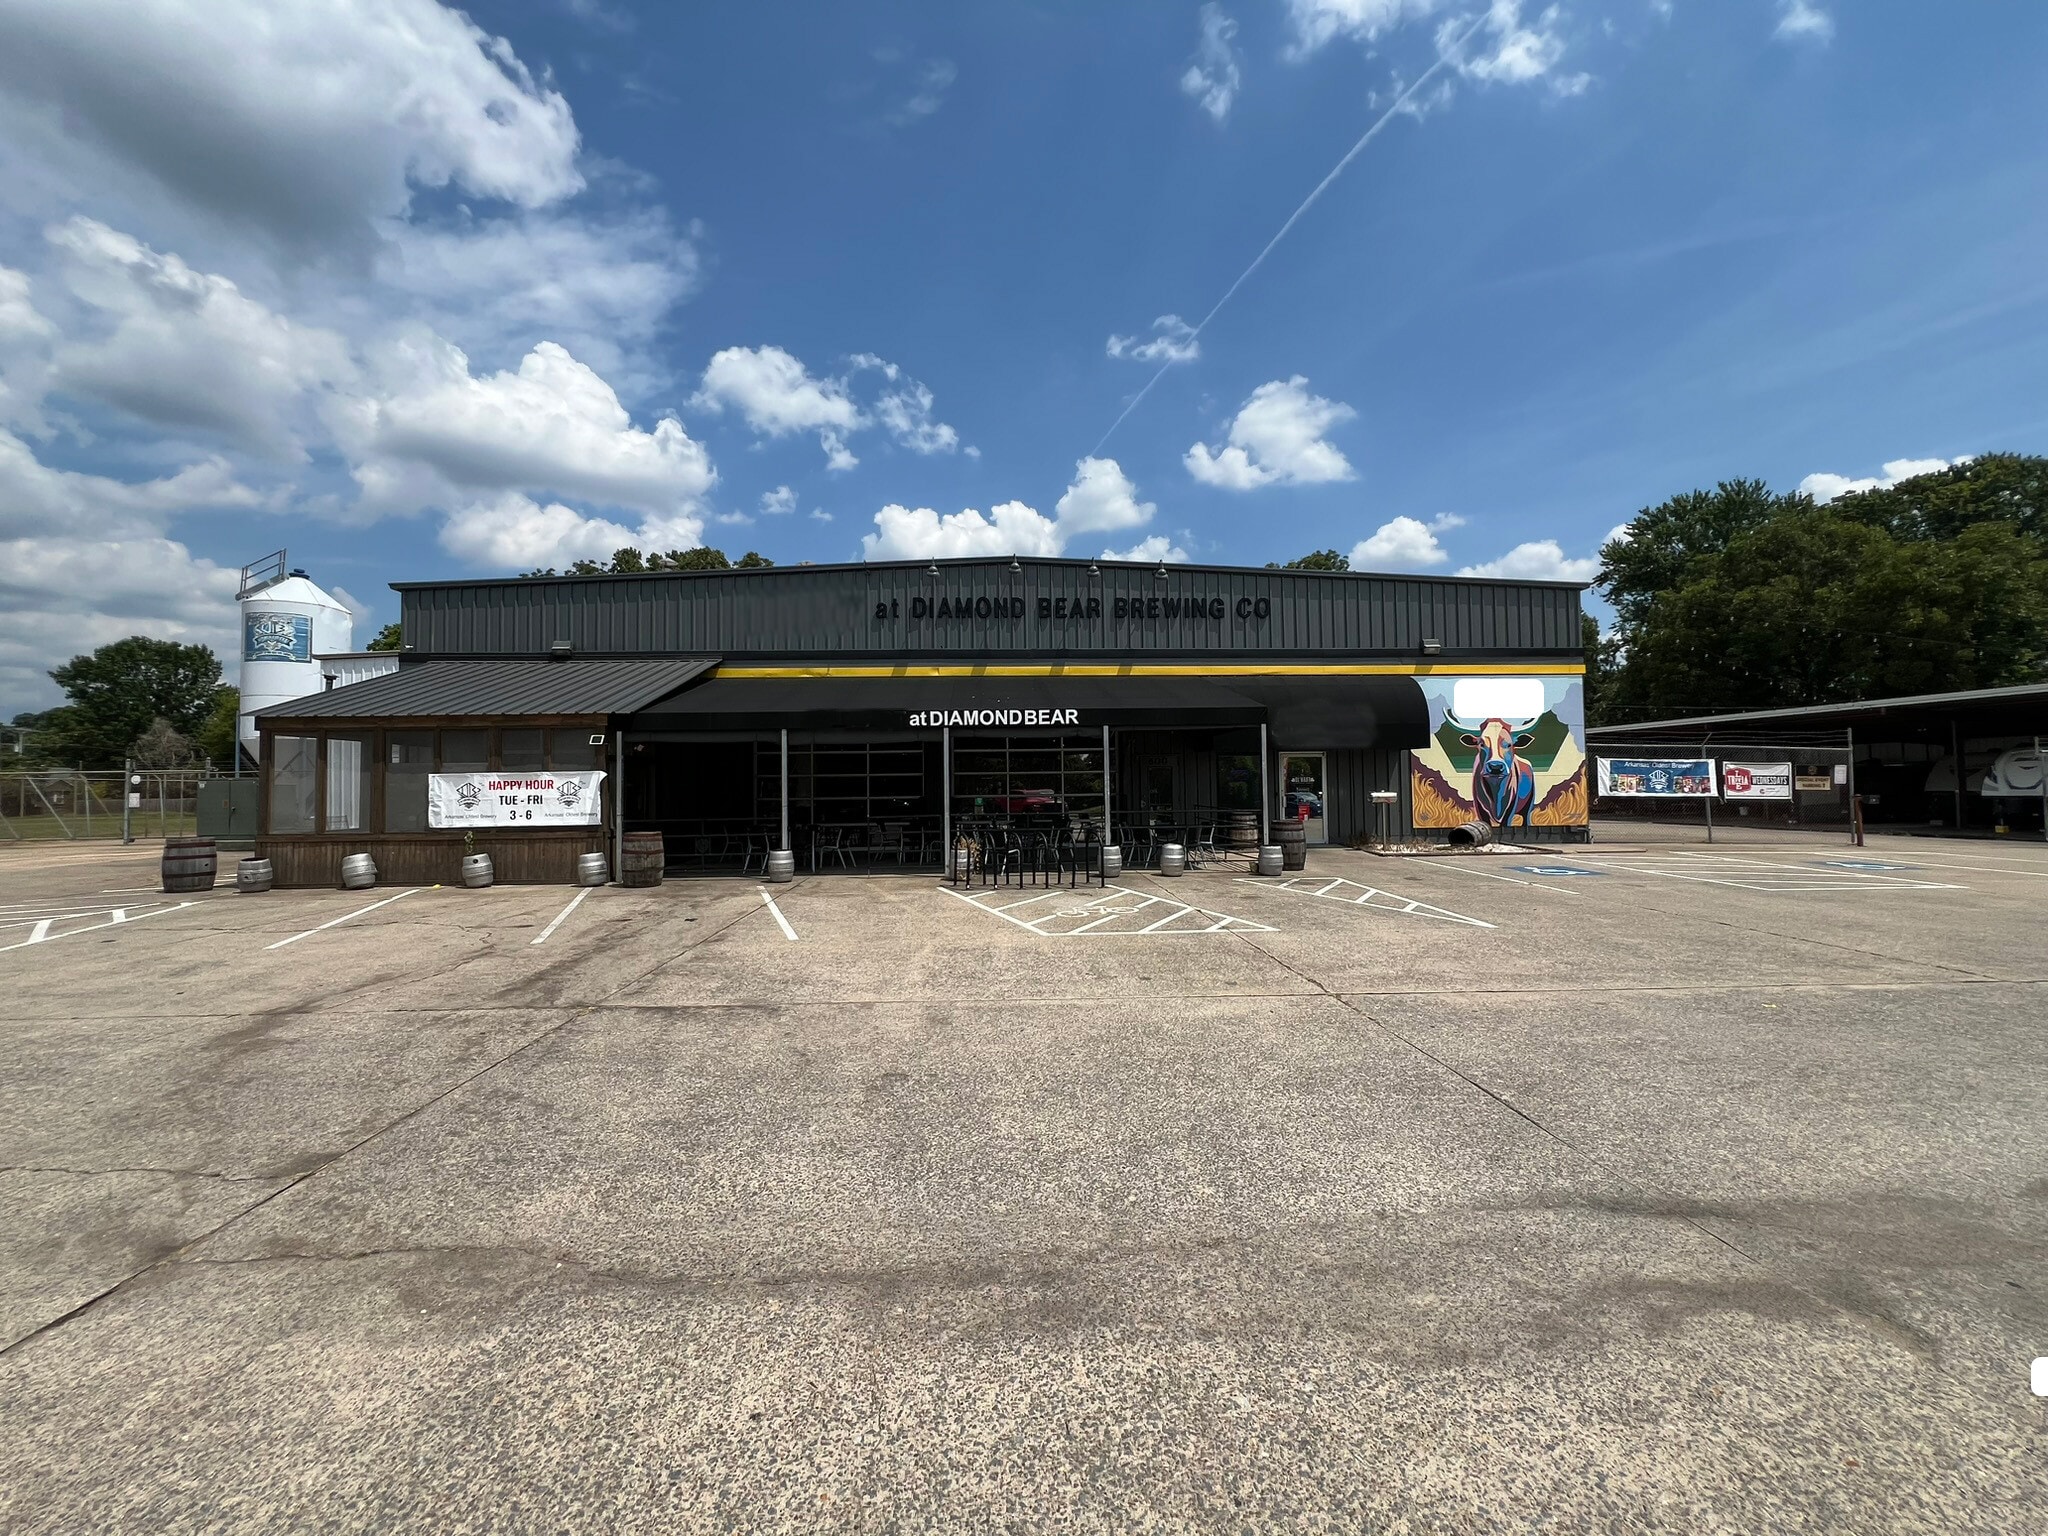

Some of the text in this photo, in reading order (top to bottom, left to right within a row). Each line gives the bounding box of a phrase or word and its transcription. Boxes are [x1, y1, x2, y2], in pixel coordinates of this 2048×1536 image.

[875, 596, 1270, 619] at DIAMOND BEAR BREWING CO
[488, 779, 554, 791] HAPPY HOUR
[499, 795, 518, 806] TUE
[527, 795, 543, 805] FRI
[509, 810, 517, 820] 3
[525, 810, 532, 820] 6
